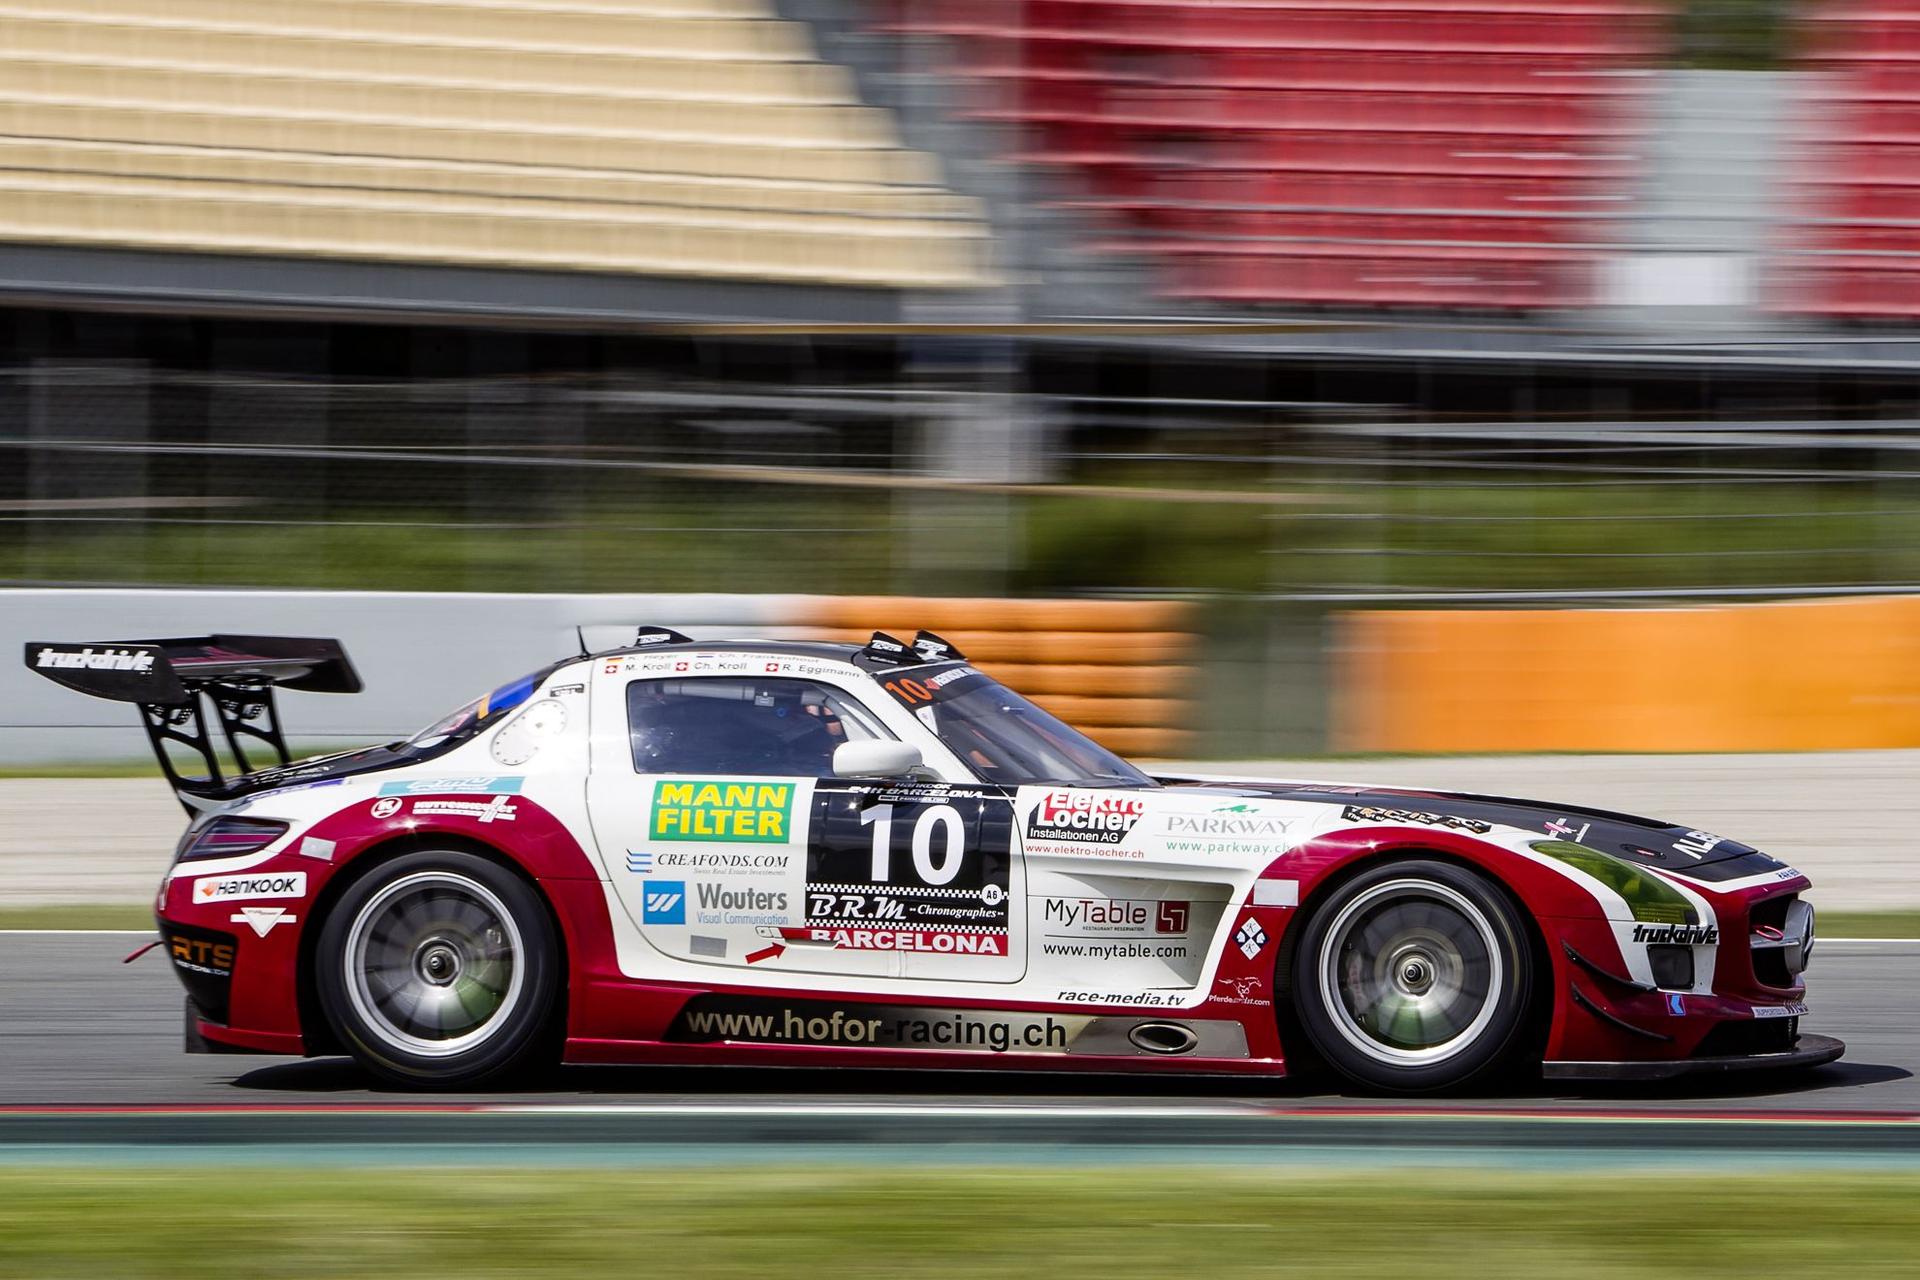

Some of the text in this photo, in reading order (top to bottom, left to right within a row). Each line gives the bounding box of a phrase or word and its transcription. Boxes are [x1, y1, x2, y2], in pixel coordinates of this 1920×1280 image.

[642, 662, 672, 671] Kroll
[694, 662, 748, 670] Ch. Kroll
[782, 663, 861, 679] R. Eggimann
[884, 678, 933, 704] 10
[660, 783, 788, 808] MANN
[1049, 791, 1145, 813] Elektro
[656, 808, 784, 837] FILTER
[1036, 808, 1143, 832] Locher
[1167, 816, 1295, 835] PARKWAY
[860, 803, 966, 886] 10
[1030, 828, 1119, 843] Installationen AG
[1025, 844, 1145, 859] www.elektro-locher.ch
[1166, 839, 1291, 855] www.parkway.ch
[657, 853, 789, 868] CREAFONDS.COM
[696, 882, 788, 911] Wouters
[985, 890, 998, 900] A6
[809, 893, 998, 920] B.R.M Chronographes
[1045, 899, 1147, 927] MyTable
[697, 911, 789, 926] Visual Communication
[810, 929, 1000, 954] BARCELONA
[1632, 924, 1719, 945] truckdrive
[171, 935, 234, 969] RTS
[1043, 943, 1187, 960] www.mytable.com
[1057, 989, 1187, 1007] race-media.tv
[686, 1009, 1067, 1051] www.hofor-racing.ch
